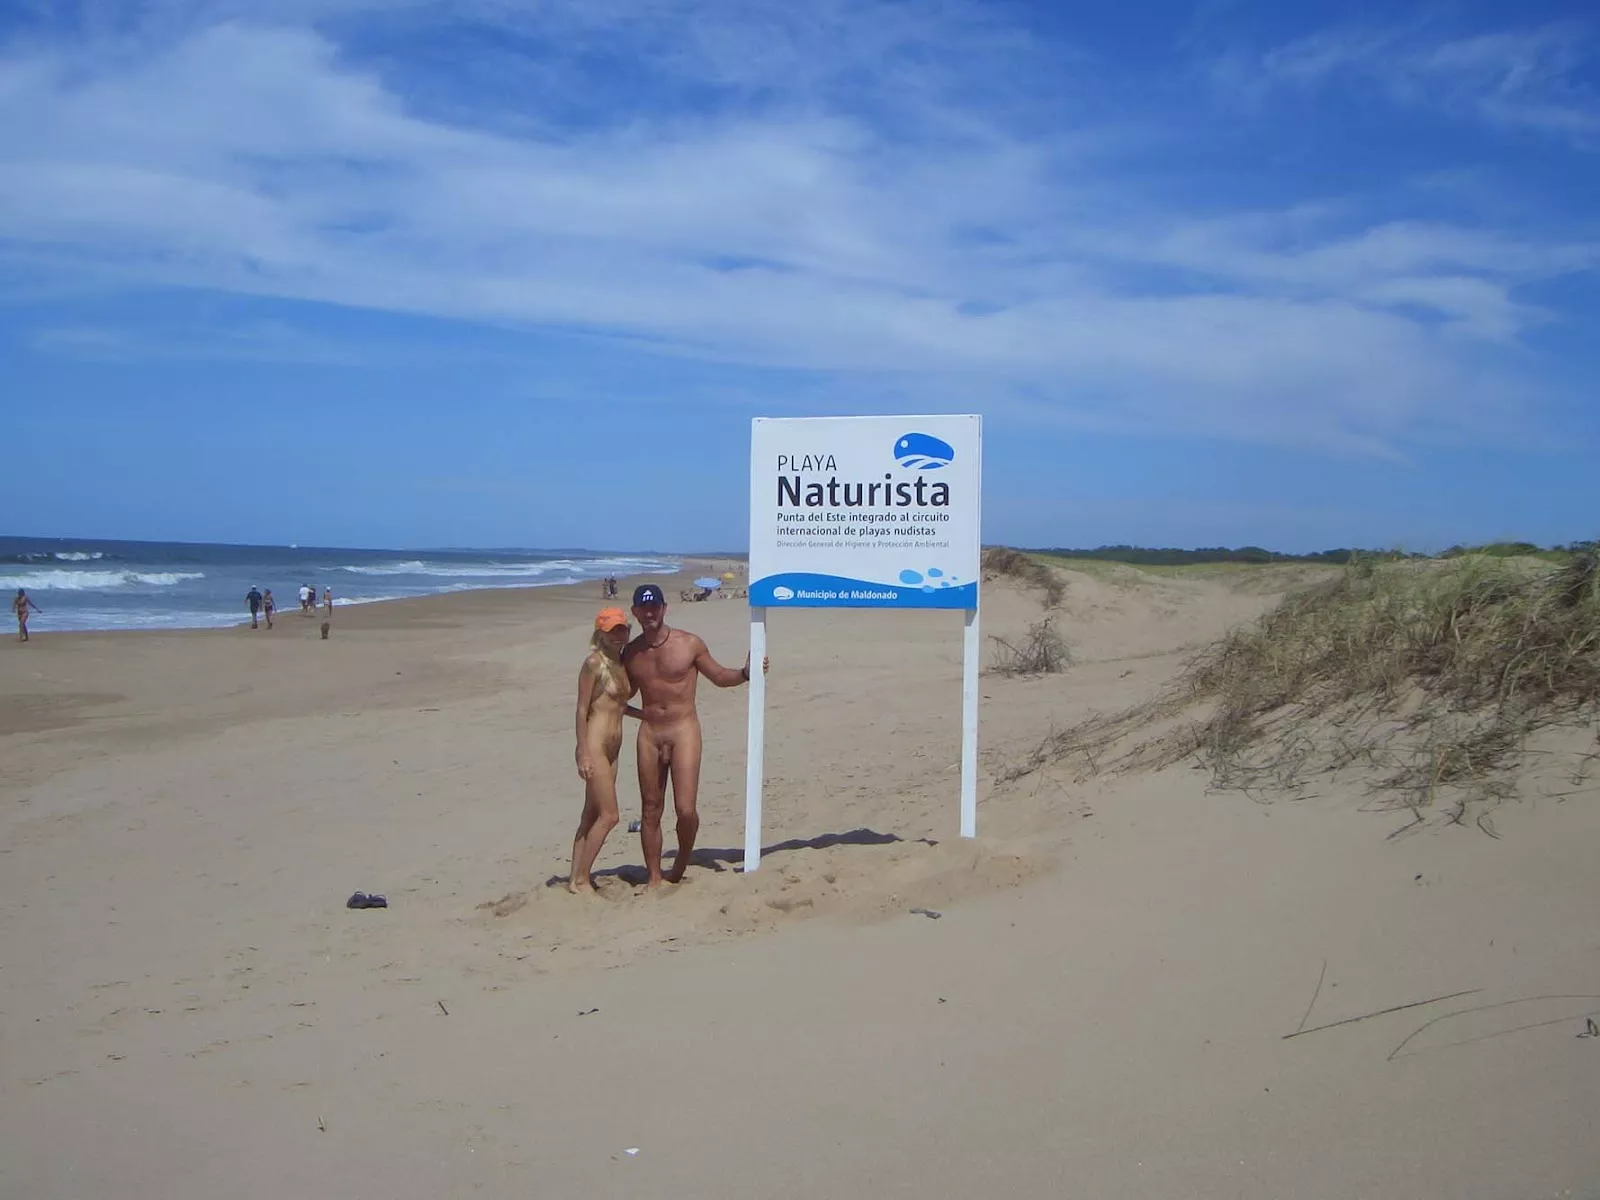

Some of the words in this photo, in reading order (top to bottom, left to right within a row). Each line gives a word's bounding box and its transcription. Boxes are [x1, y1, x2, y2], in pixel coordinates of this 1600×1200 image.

[777, 455, 837, 472] PLAYA
[777, 473, 950, 507] Naturista
[777, 513, 805, 522] Punta
[808, 513, 823, 522] del
[826, 513, 846, 522] Este
[849, 513, 897, 524] integrado
[900, 513, 909, 522] al
[912, 513, 950, 522] circuito
[777, 526, 841, 536] internacional
[844, 526, 856, 536] de
[859, 526, 891, 537] playas
[894, 526, 936, 536] nudistas
[777, 540, 807, 548] Dirección
[808, 540, 833, 548] General
[835, 540, 844, 548] de
[845, 540, 870, 549] Higiene
[878, 540, 913, 548] Protección
[914, 540, 949, 548] Ambiental
[797, 590, 836, 600] Municipio
[838, 590, 849, 599] de
[851, 590, 897, 600] Maldonado
